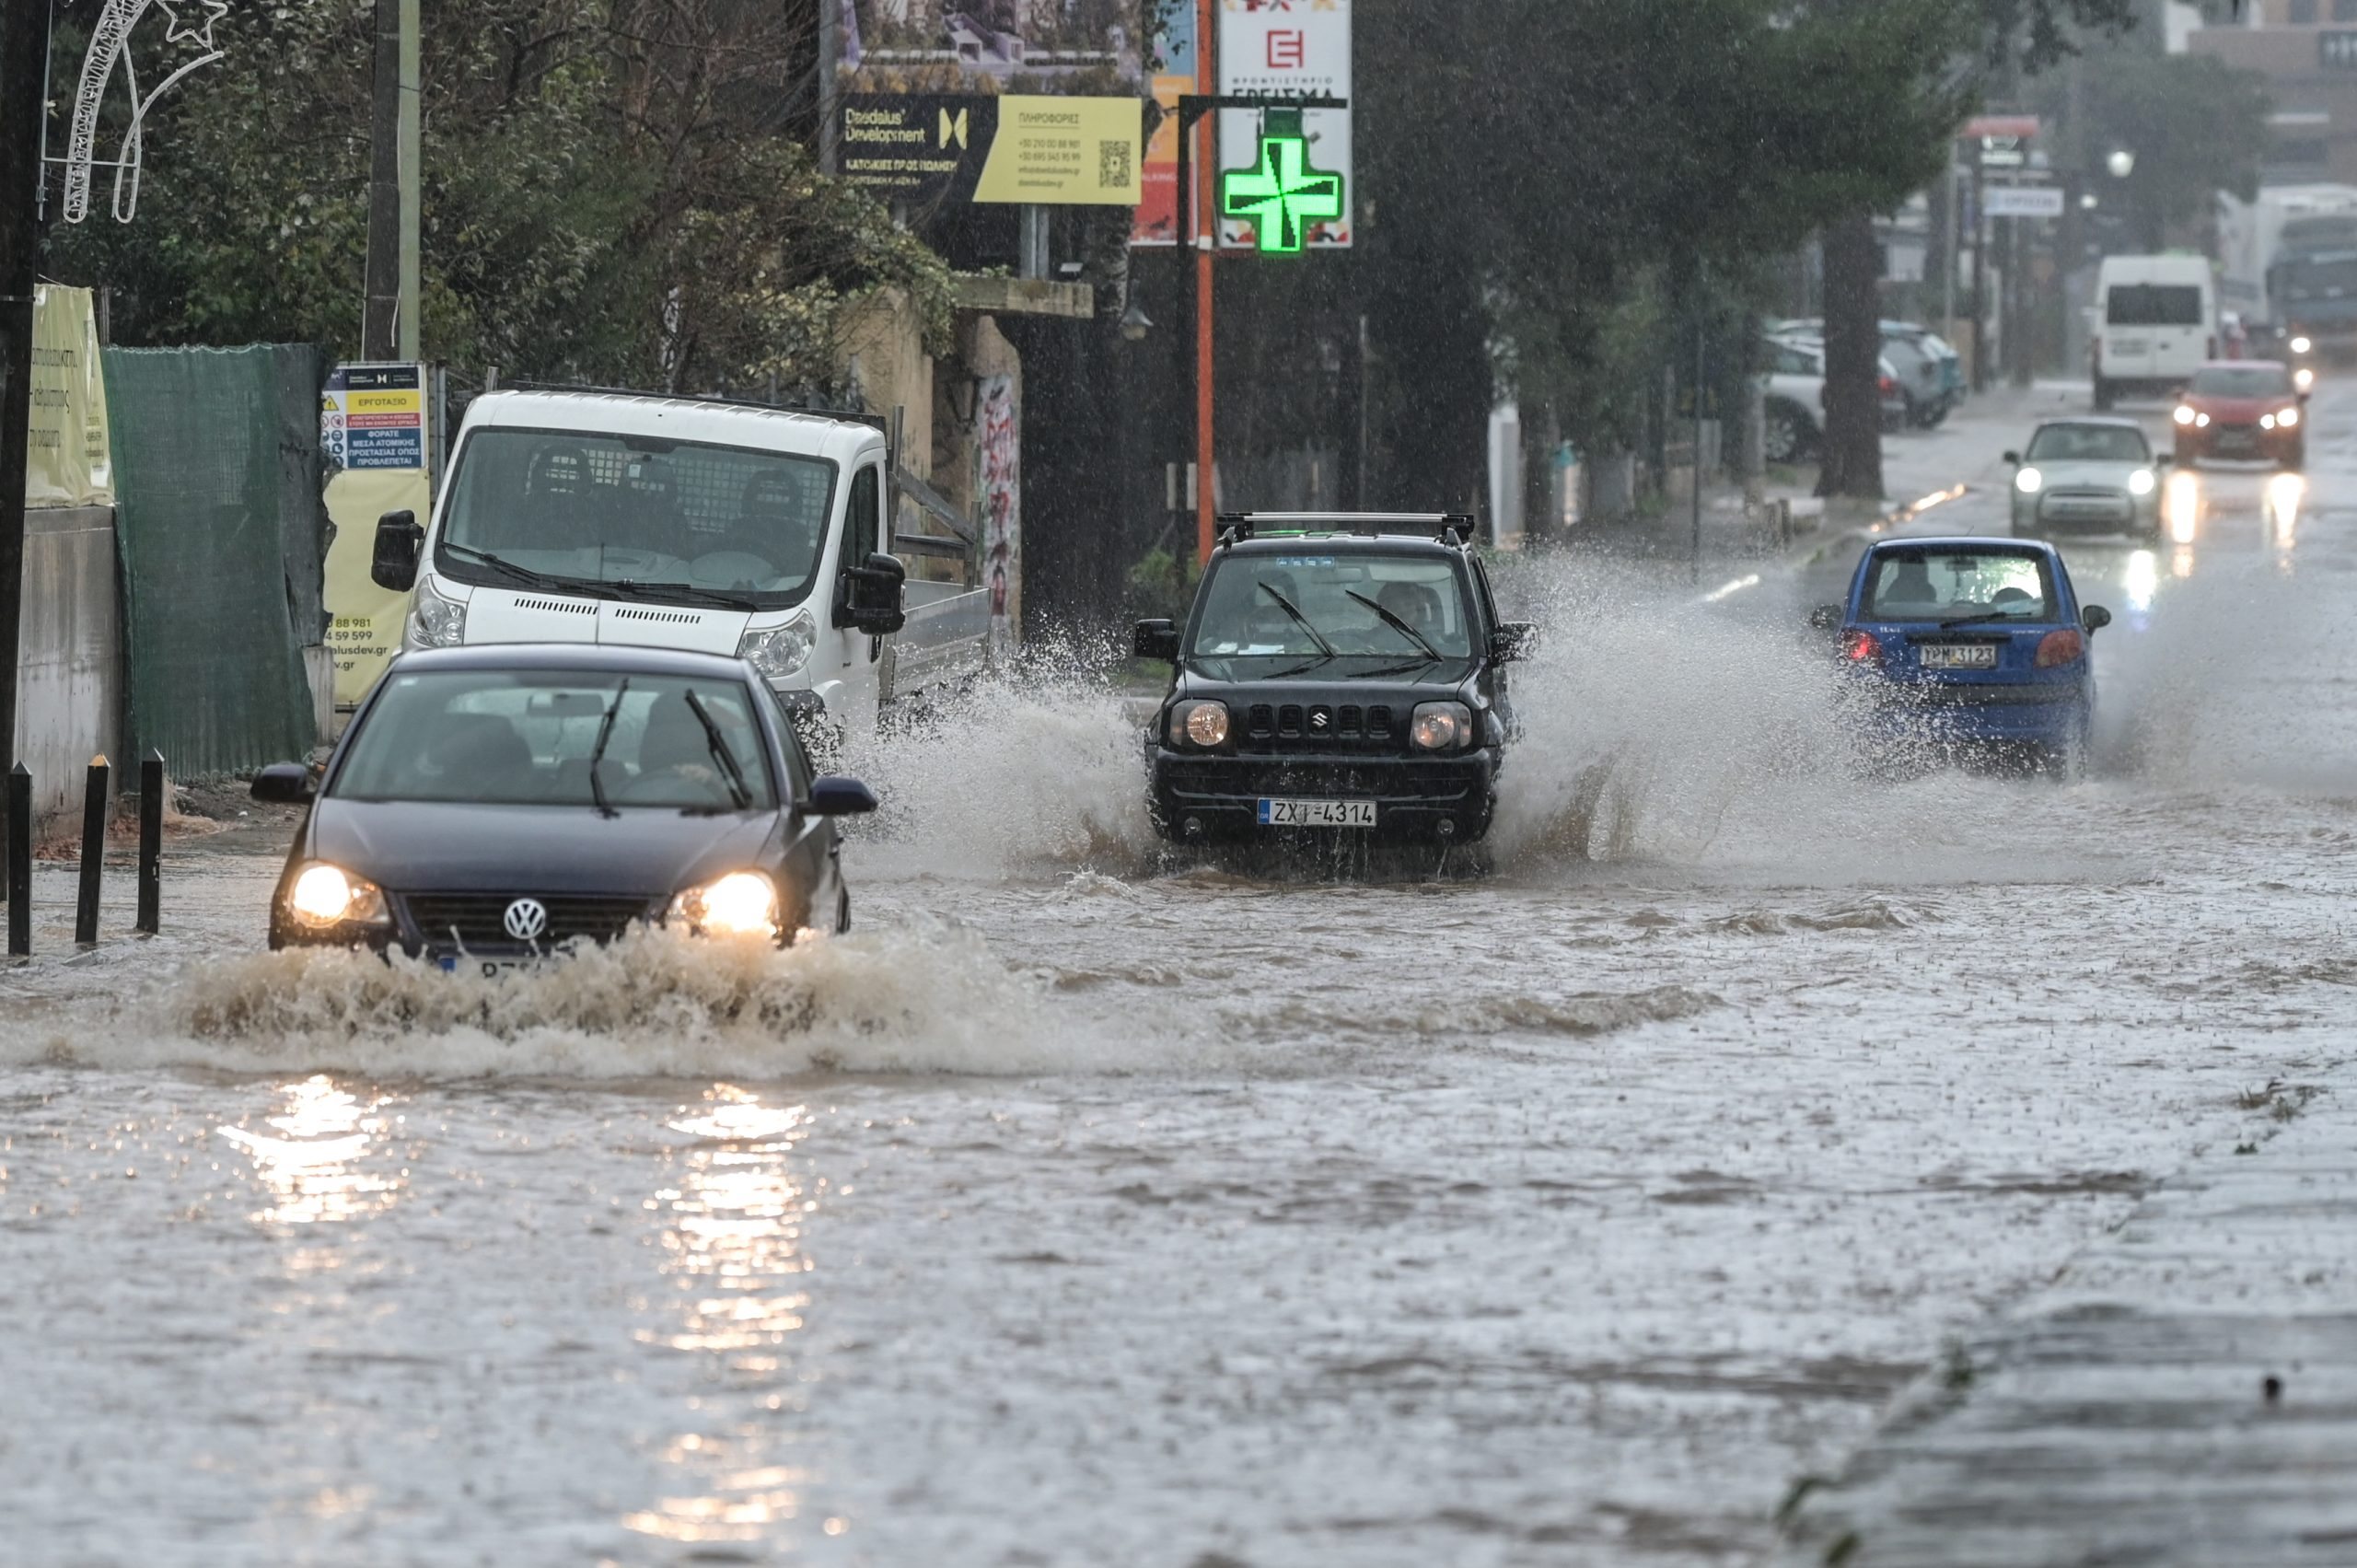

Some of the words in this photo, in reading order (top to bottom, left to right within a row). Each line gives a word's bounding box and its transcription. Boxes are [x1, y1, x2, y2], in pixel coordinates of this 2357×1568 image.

[1018, 111, 1079, 124] ΠΛΗΡΟΦΟΡΙΕΣ
[845, 126, 925, 144] Development
[358, 398, 407, 407] ΕΡΓΟΤΑΞΙΟ
[367, 430, 400, 438] ΦΟΡΑΤΕ
[353, 439, 375, 447] ΜΕΣΑ
[349, 448, 396, 457] ΠΡΟΣΤΑΣΙΑΣ
[398, 447, 420, 456] ΟΠΩΣ
[357, 458, 412, 466] ΠΡΟΒΛΕΠΕΤΑΙ
[335, 618, 350, 628] 88
[352, 618, 371, 628] 981
[335, 631, 349, 641] 59
[352, 631, 373, 641] 599
